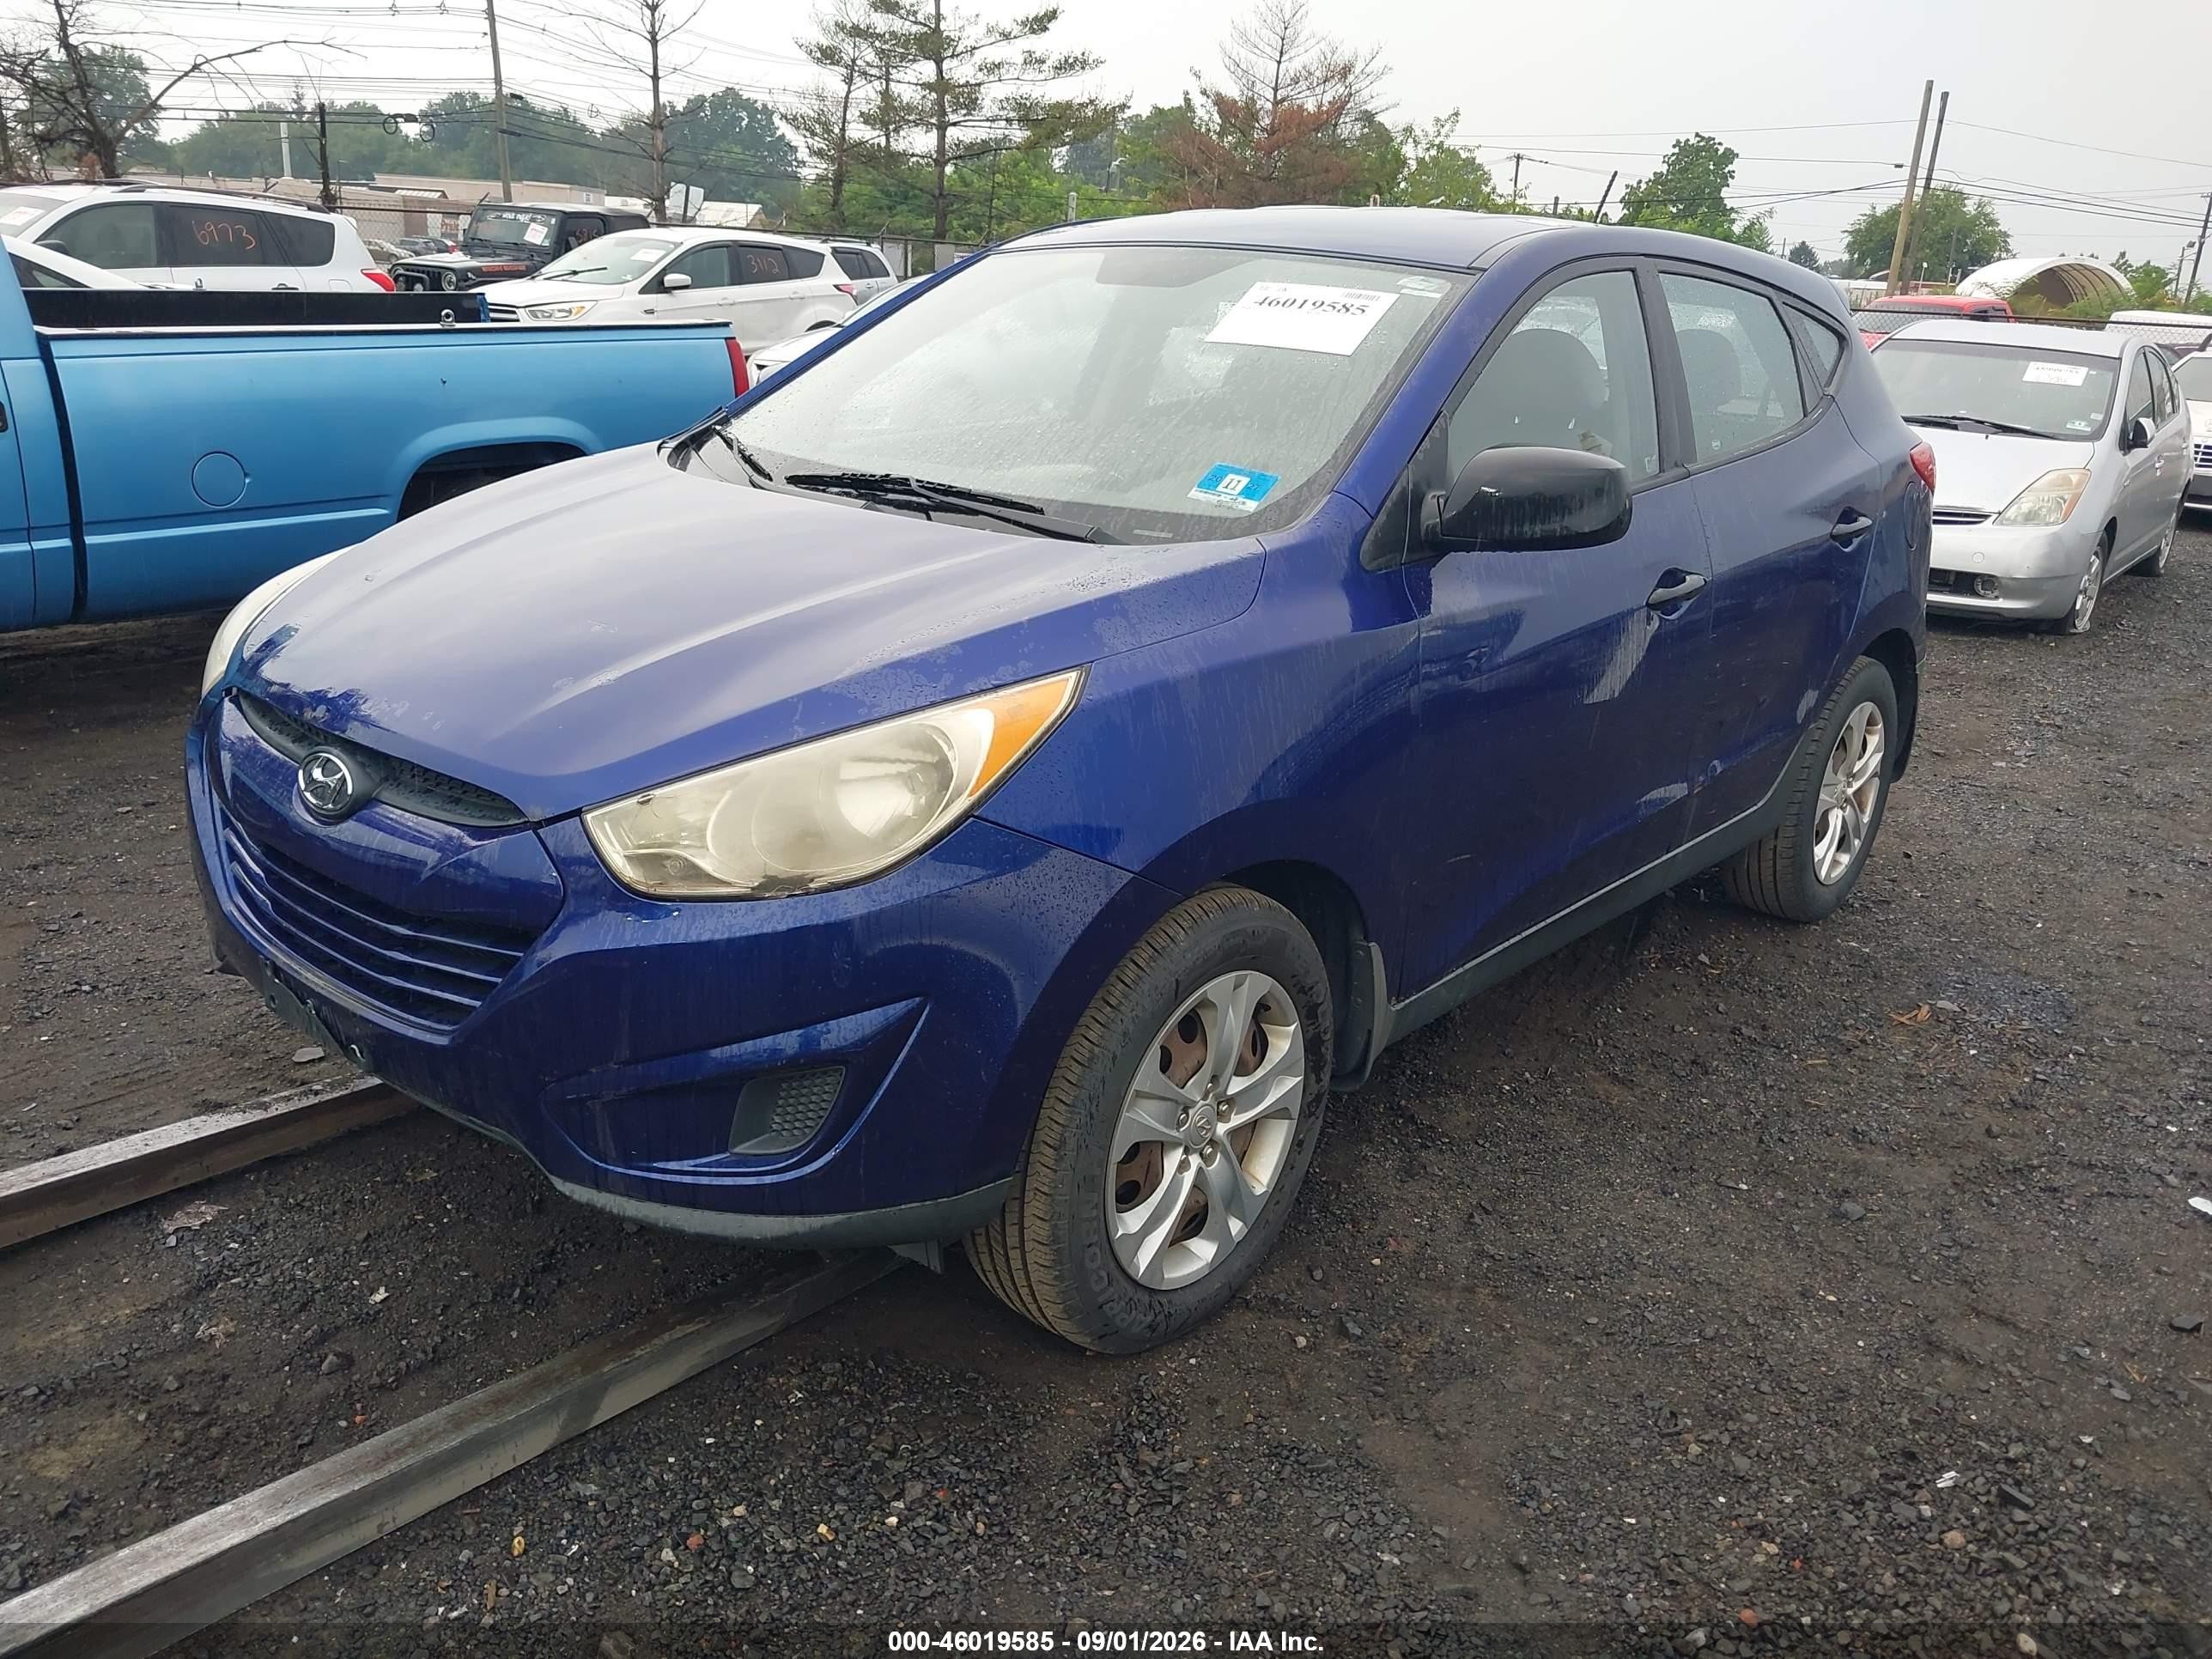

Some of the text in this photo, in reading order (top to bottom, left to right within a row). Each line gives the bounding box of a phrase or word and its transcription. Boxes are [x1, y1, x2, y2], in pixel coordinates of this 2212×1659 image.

[191, 220, 257, 251] 6973
[746, 254, 781, 275] 3112
[1254, 295, 1371, 316] 46019585
[1208, 474, 1223, 483] 20
[1222, 477, 1242, 492] 11
